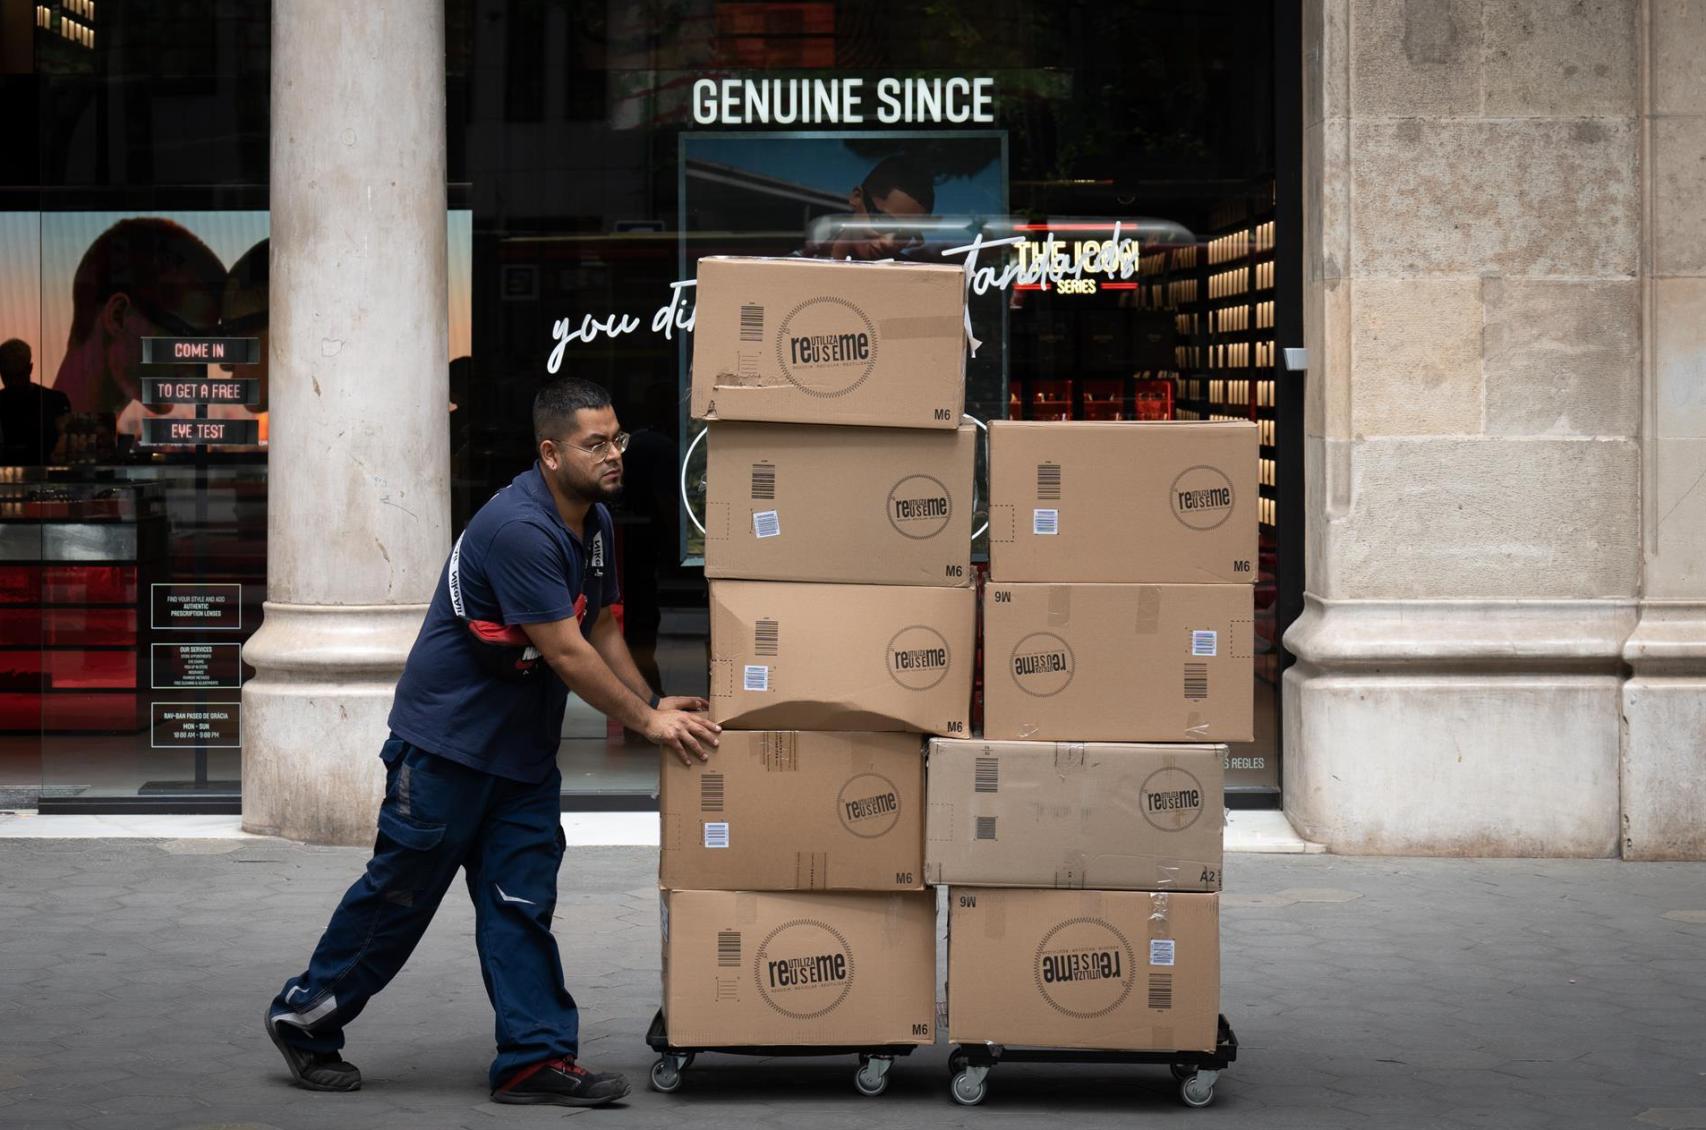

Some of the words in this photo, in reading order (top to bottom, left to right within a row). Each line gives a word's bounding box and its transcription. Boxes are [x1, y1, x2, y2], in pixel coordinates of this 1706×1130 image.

[693, 78, 863, 124] GENUINE
[877, 77, 994, 124] SINCE
[1057, 279, 1097, 294] SERIES
[547, 313, 640, 374] you
[652, 279, 698, 340] di
[174, 343, 209, 358] COME
[212, 343, 224, 358] IN
[157, 383, 173, 398] TO
[175, 383, 198, 398] GET
[200, 384, 209, 398] A
[212, 384, 241, 399] FREE
[934, 408, 951, 421] M6
[171, 423, 193, 439] EYE
[196, 424, 225, 439] TEST
[945, 565, 963, 578] M6
[1233, 560, 1250, 573] M6
[994, 591, 1011, 603] M6
[947, 720, 963, 733] M6
[1231, 757, 1265, 769] REGLES
[896, 872, 913, 884] M6
[1200, 871, 1215, 883] A2
[959, 896, 976, 908] M6
[912, 1023, 928, 1036] M6
